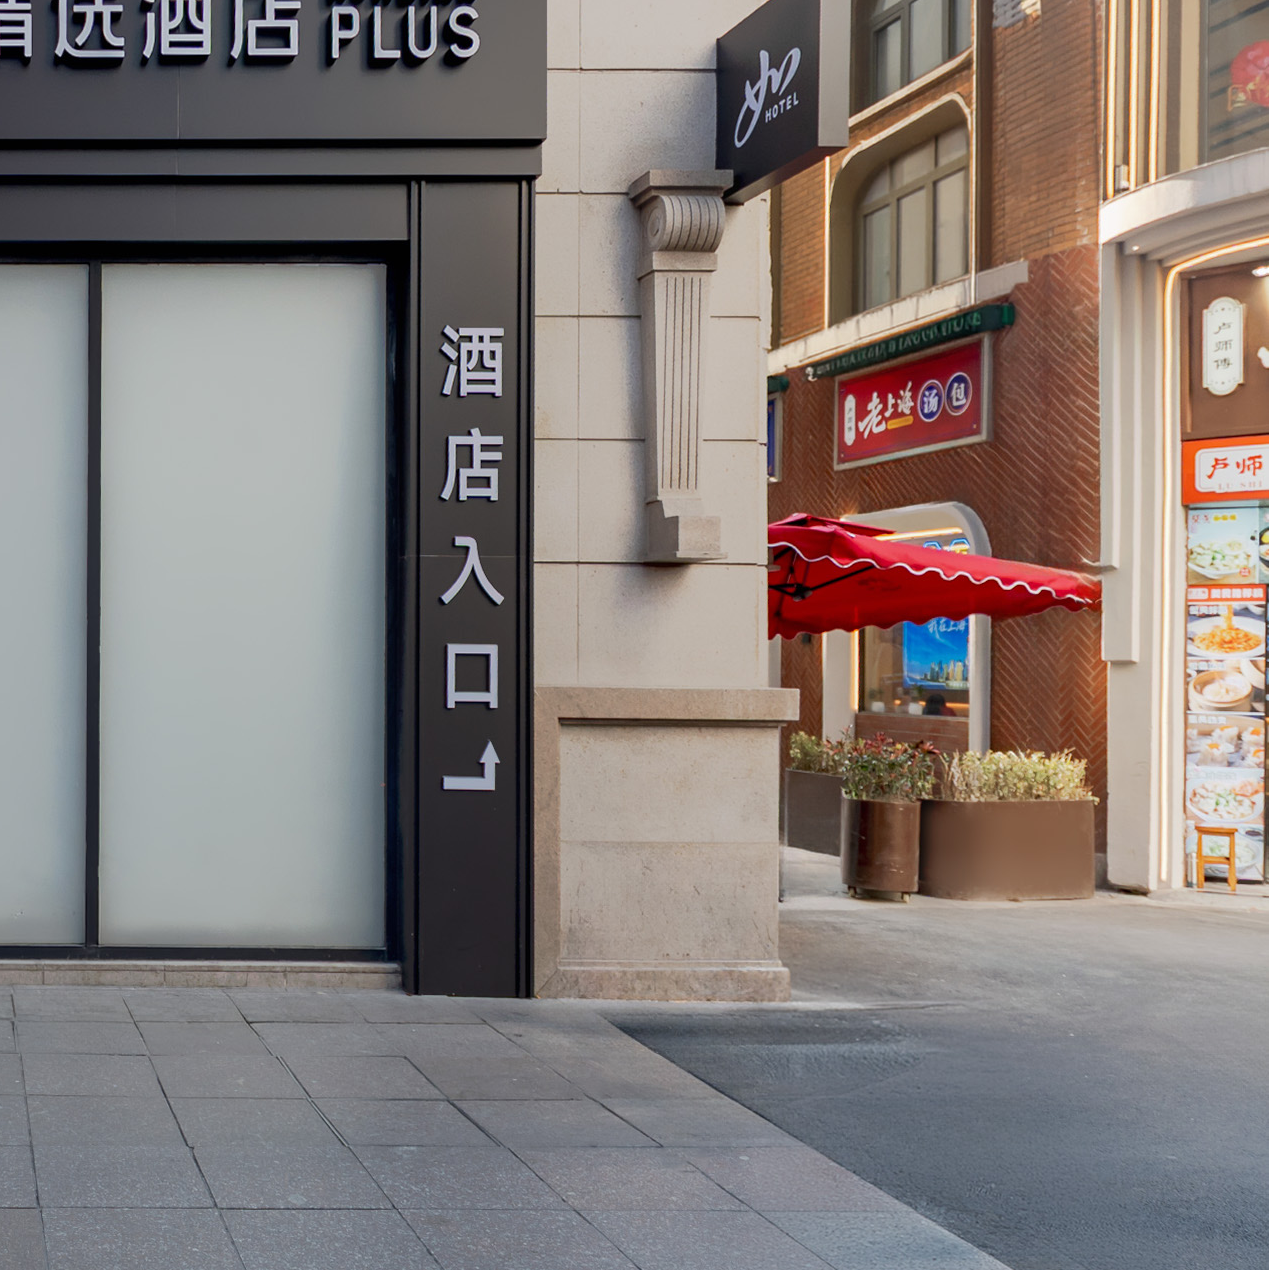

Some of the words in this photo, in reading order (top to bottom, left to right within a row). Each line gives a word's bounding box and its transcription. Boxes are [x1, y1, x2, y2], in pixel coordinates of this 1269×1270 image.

[332, 5, 481, 59] PLUS
[764, 92, 799, 123] HOTEL
[1206, 454, 1263, 479] 卢师
[440, 324, 505, 709] 酒店入口
